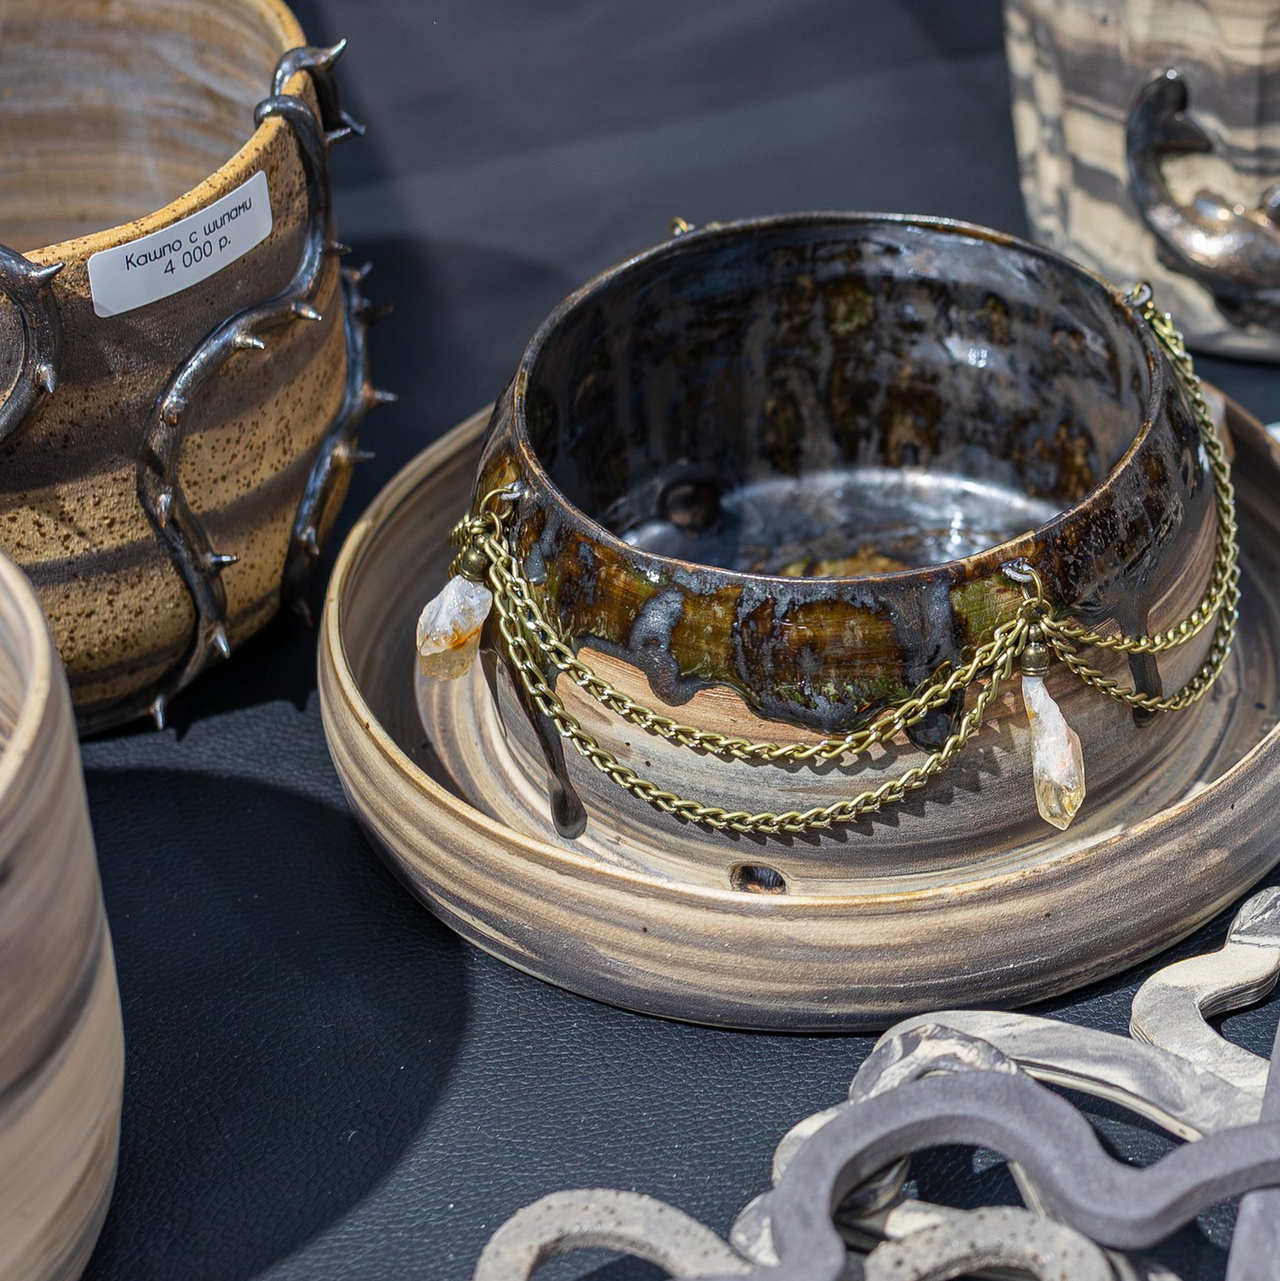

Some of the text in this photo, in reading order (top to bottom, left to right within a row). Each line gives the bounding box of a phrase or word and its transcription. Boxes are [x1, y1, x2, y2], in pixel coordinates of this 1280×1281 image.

[125, 197, 252, 271] Кашпо с шипами
[163, 236, 232, 275] 4 000 р.
